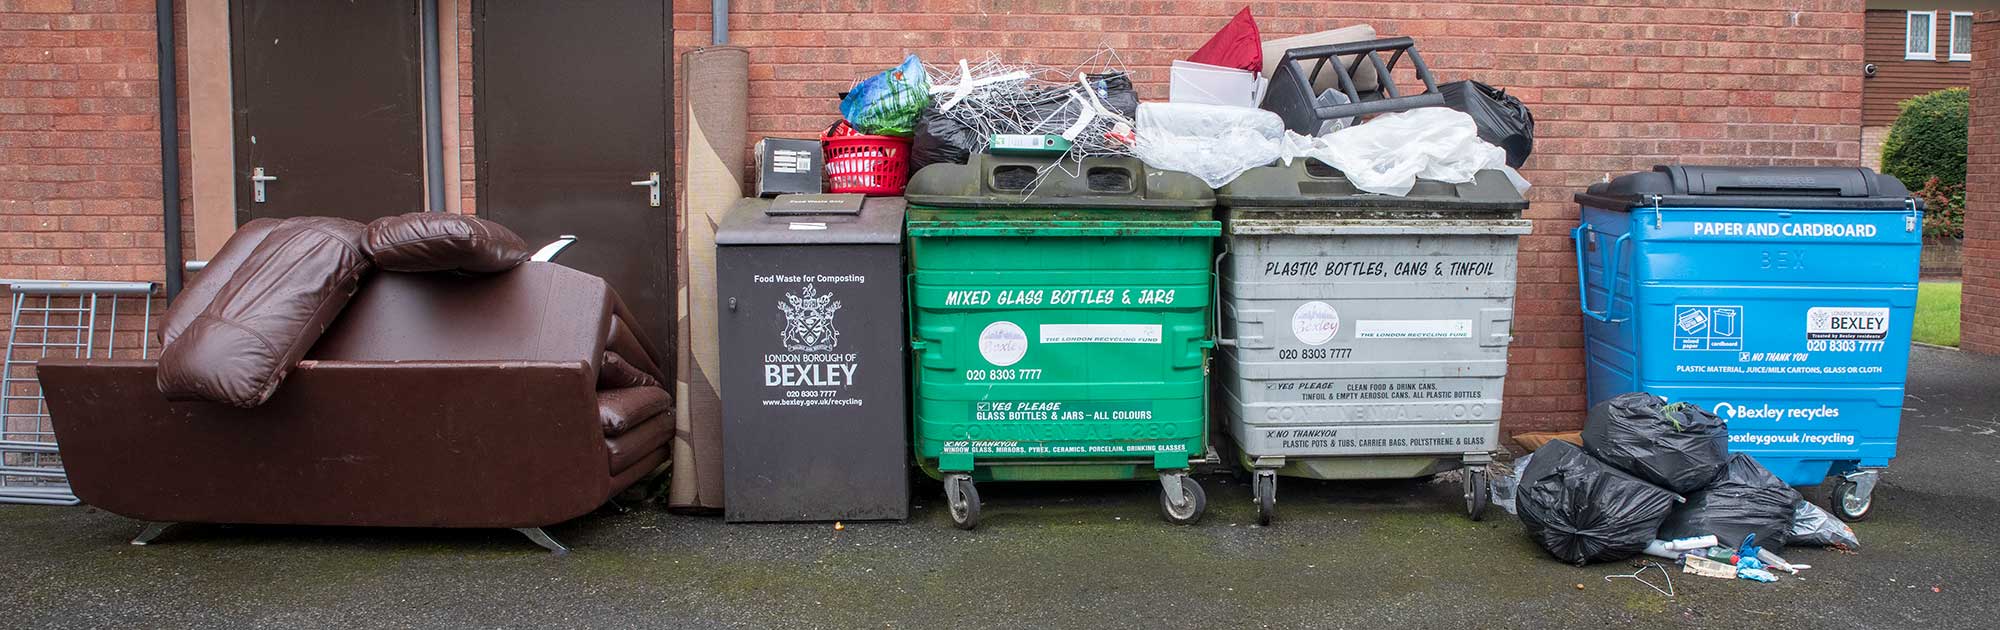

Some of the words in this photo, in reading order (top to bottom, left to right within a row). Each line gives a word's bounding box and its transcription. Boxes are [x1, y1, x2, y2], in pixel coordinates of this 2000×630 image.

[1694, 222, 1742, 236] PAPER
[1746, 224, 1780, 236] AND
[1784, 223, 1876, 238] CARDBOARD
[1264, 262, 1318, 276] PLASTIC
[1324, 262, 1388, 278] BOTTLES,
[1394, 262, 1428, 276] CANS
[1435, 262, 1443, 276] &
[1450, 262, 1495, 276] TINFOIL
[754, 274, 774, 283] Food
[776, 274, 801, 283] Waste
[803, 274, 816, 283] for
[817, 274, 865, 284] Composting
[945, 290, 991, 306] MIXED
[996, 290, 1044, 305] GLASS
[1050, 290, 1114, 304] BOTTLES
[1122, 290, 1131, 304] &
[1138, 289, 1176, 304] JARS
[1831, 317, 1884, 329] BEXLEY
[1807, 341, 1826, 352] 020
[1829, 341, 1856, 352] 8303
[1858, 341, 1884, 352] 7777
[765, 354, 800, 363] LONDON
[803, 354, 843, 362] BOROUGH
[845, 354, 856, 362] OF
[1279, 349, 1298, 360] 020
[1302, 349, 1327, 359] 8303
[1330, 348, 1352, 359] 7777
[1752, 353, 1764, 361] NO
[1765, 353, 1790, 361] THANK
[1792, 353, 1808, 361] YOU
[765, 364, 858, 386] BEXLEY
[966, 370, 986, 380] 020
[990, 370, 1015, 380] 8303
[1019, 369, 1042, 380] 7777
[1707, 366, 1745, 374] MATERIAL,
[1746, 366, 1786, 374] JUICE/MILK
[1787, 366, 1822, 374] CARTONS,
[1824, 366, 1846, 374] GLASS
[1298, 382, 1334, 390] PLEASE
[1336, 392, 1358, 400] EMPTY
[763, 398, 862, 406] www.bexley.gov.uk/recycling
[992, 402, 1012, 410] YES
[1017, 402, 1061, 410] PLEASE
[976, 411, 1006, 420] GLASS
[1009, 411, 1047, 420] BOTTLES
[1051, 411, 1059, 420] &
[1112, 411, 1152, 420] COLOURS
[1738, 404, 1785, 421] Bexley
[1788, 404, 1839, 420] recycles
[1293, 430, 1337, 438] THANKYOU
[1801, 433, 1854, 445] /recycling
[1283, 440, 1309, 448] PLASTIC
[1311, 440, 1328, 448] POTS
[1359, 439, 1387, 447] CARRIER
[1410, 438, 1453, 446] POLYSTYRENE
